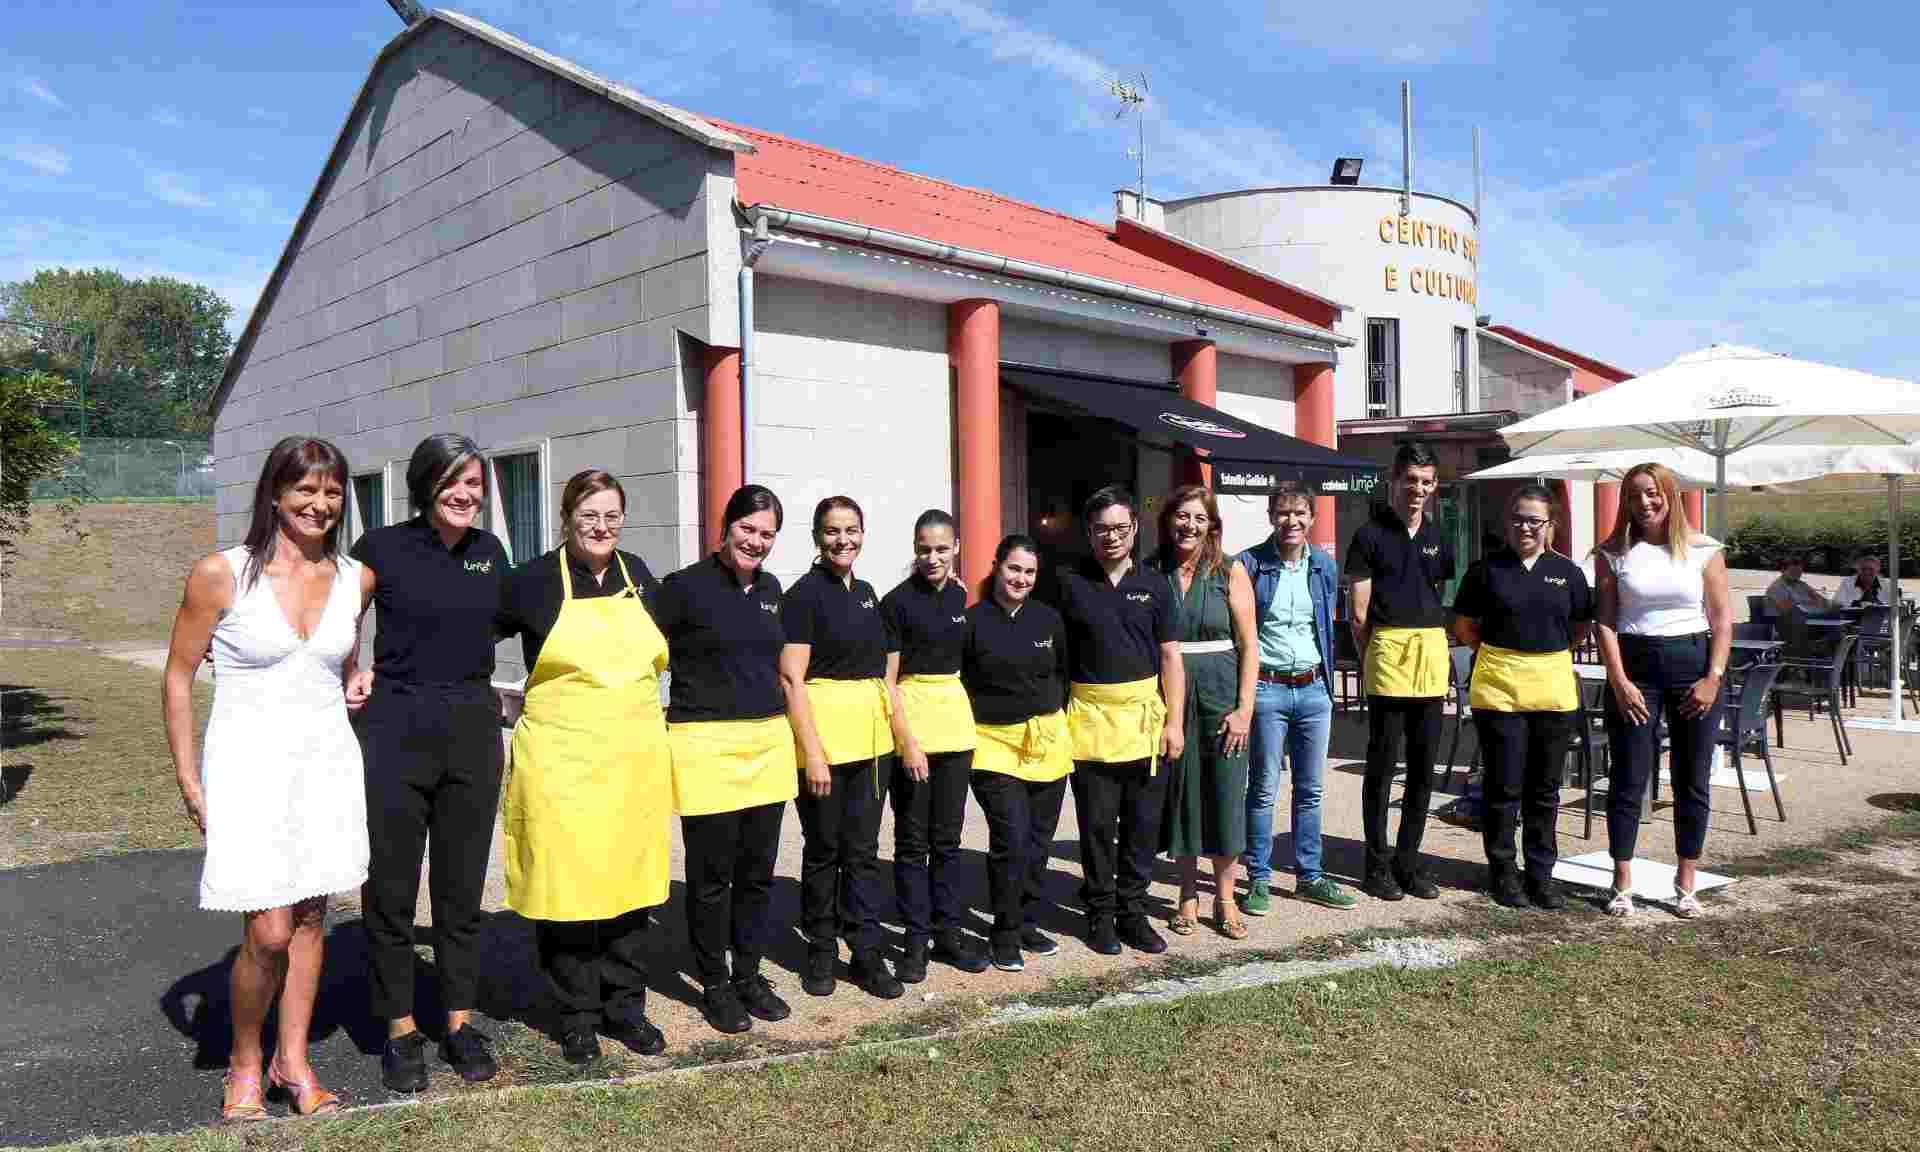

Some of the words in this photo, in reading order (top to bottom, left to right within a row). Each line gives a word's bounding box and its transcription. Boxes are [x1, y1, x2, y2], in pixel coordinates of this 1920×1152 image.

[1378, 217, 1458, 254] CENTRO
[1384, 265, 1398, 292] E
[1409, 266, 1476, 304] CULTU
